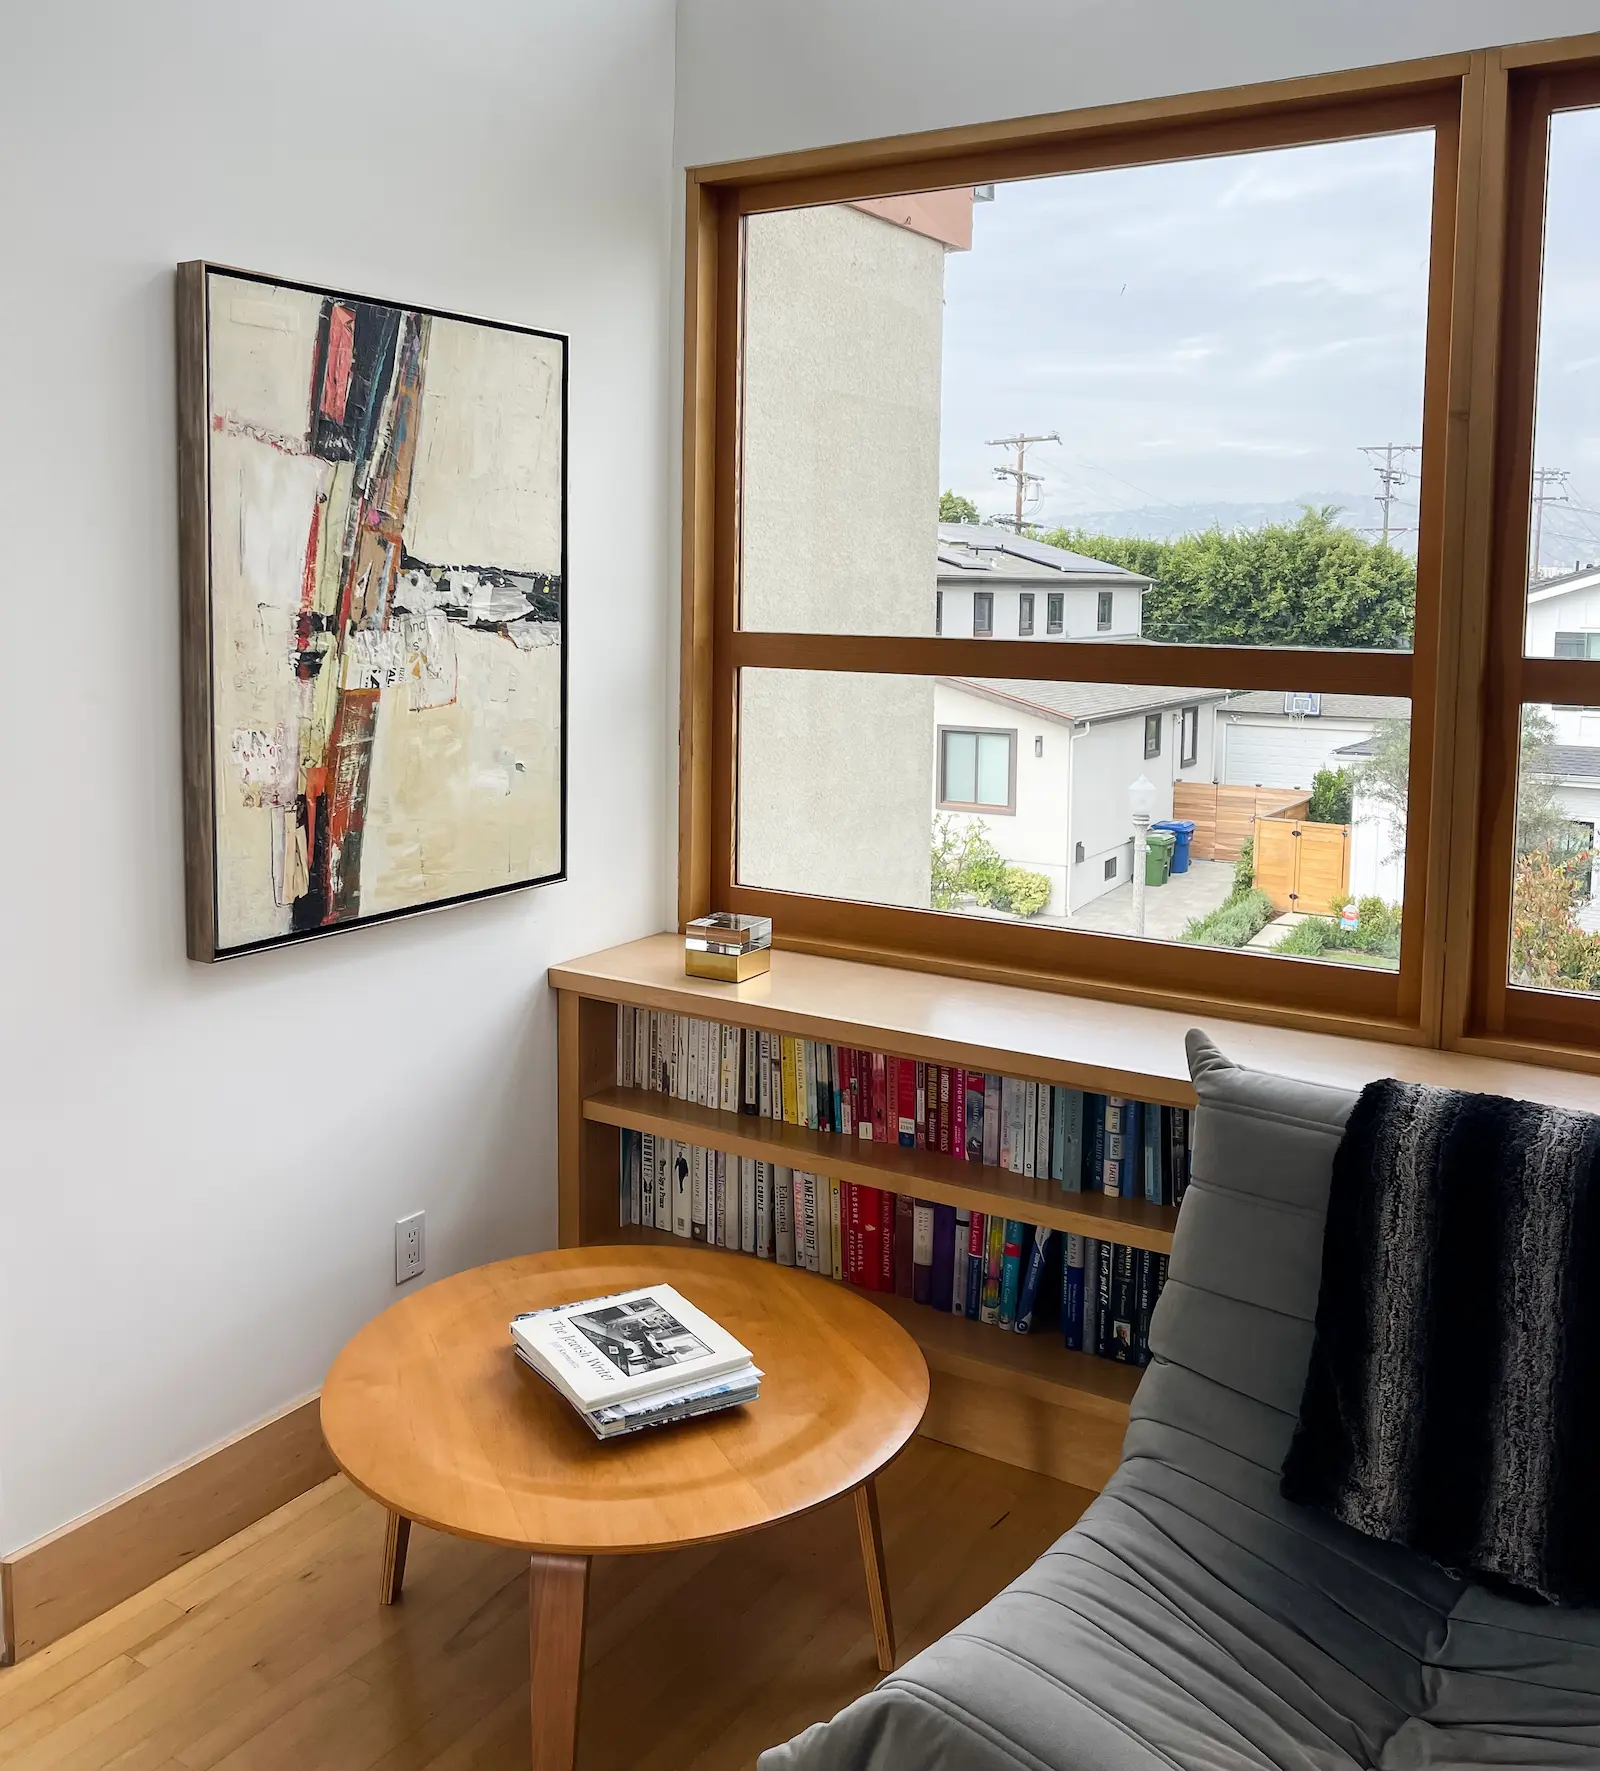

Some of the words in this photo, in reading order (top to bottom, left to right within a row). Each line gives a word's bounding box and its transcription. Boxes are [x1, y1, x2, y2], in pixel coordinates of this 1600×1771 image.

[941, 1103, 949, 1129] DOUBLE
[941, 1129, 949, 1152] CROSS
[658, 1176, 666, 1186] Spy
[1109, 1163, 1117, 1182] PLACES
[779, 1185, 788, 1233] Educated
[795, 1181, 803, 1239] UNLEASHED
[804, 1179, 814, 1227] AMERICAN
[806, 1229, 815, 1251] DIRT
[549, 1320, 567, 1334] The
[558, 1335, 593, 1358] Jewish
[586, 1358, 616, 1381] Writer
